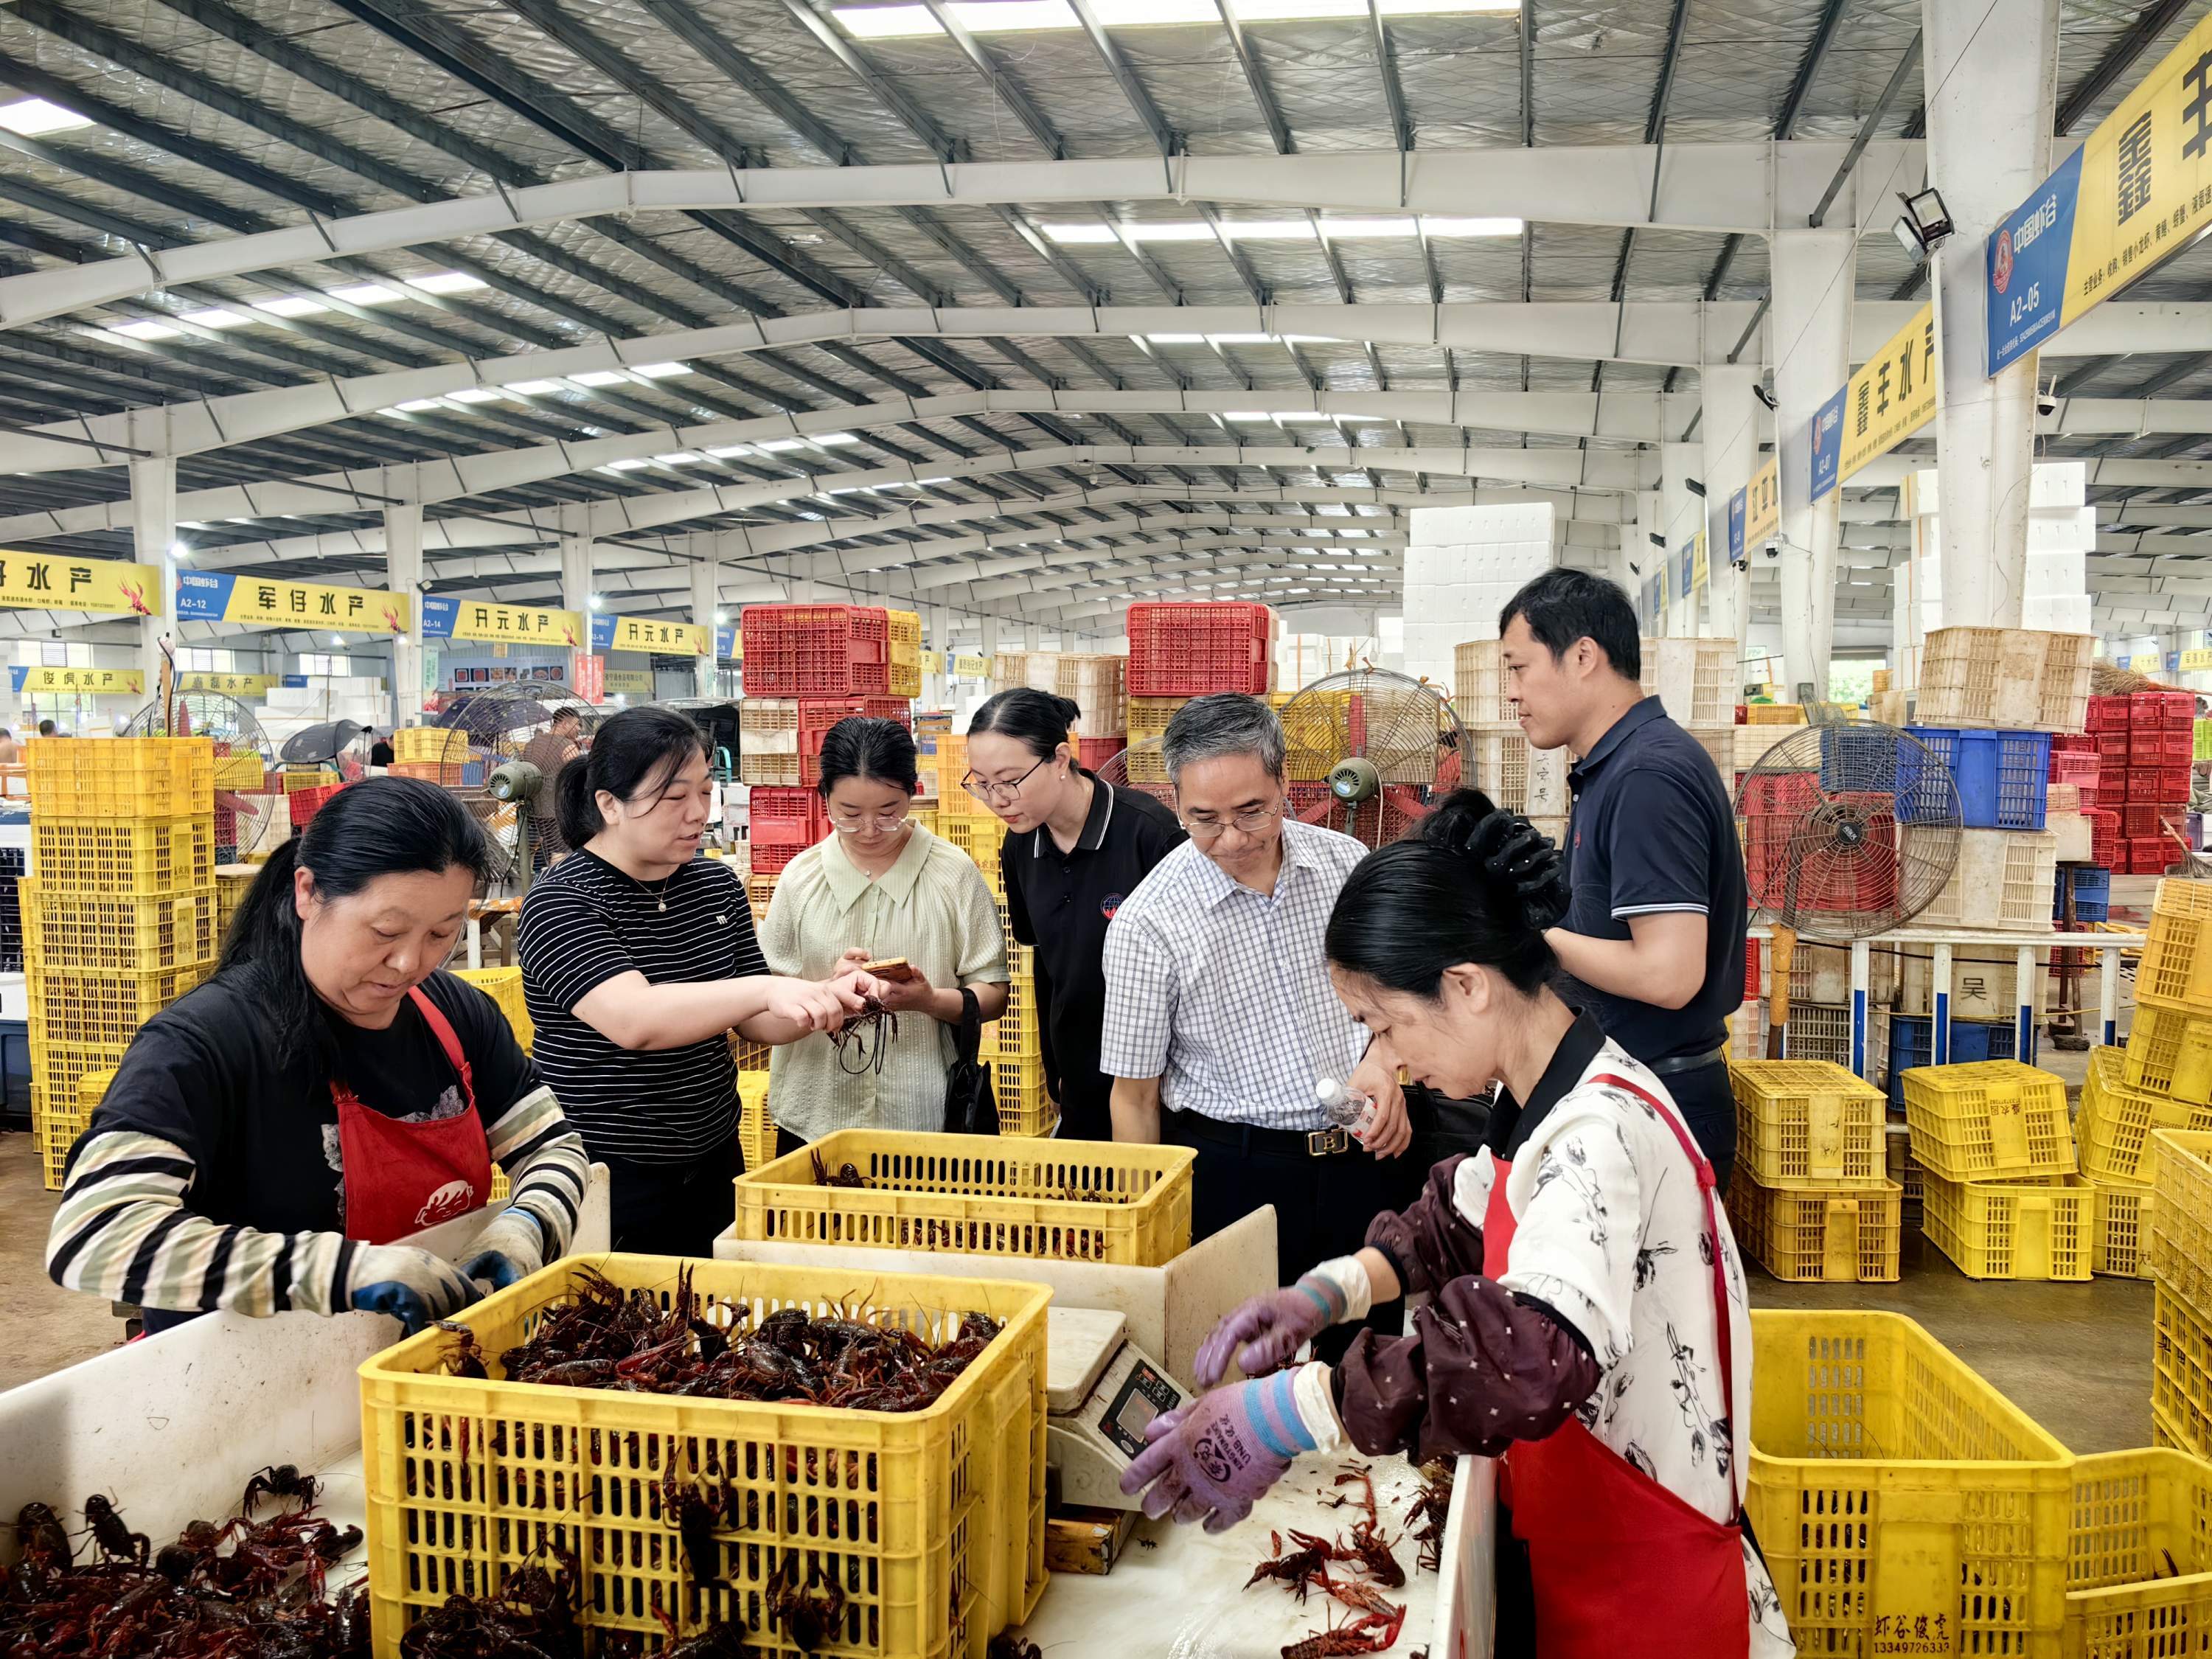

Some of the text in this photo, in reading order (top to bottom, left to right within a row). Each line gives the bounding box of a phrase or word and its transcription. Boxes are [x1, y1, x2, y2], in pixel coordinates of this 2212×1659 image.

[2118, 49, 2212, 227] 鑫丰
[2014, 193, 2057, 254] 中国虾谷
[2010, 281, 2039, 327] A2-05
[183, 575, 218, 588] 中国虾谷
[180, 598, 206, 609] A2-12
[258, 585, 364, 616] 军仔水产
[423, 619, 441, 628] A2-14
[476, 608, 549, 632] 开元水产
[629, 623, 684, 644] 开元水产
[44, 670, 113, 686] 俊虎水产
[1960, 978, 1987, 1000] 吴
